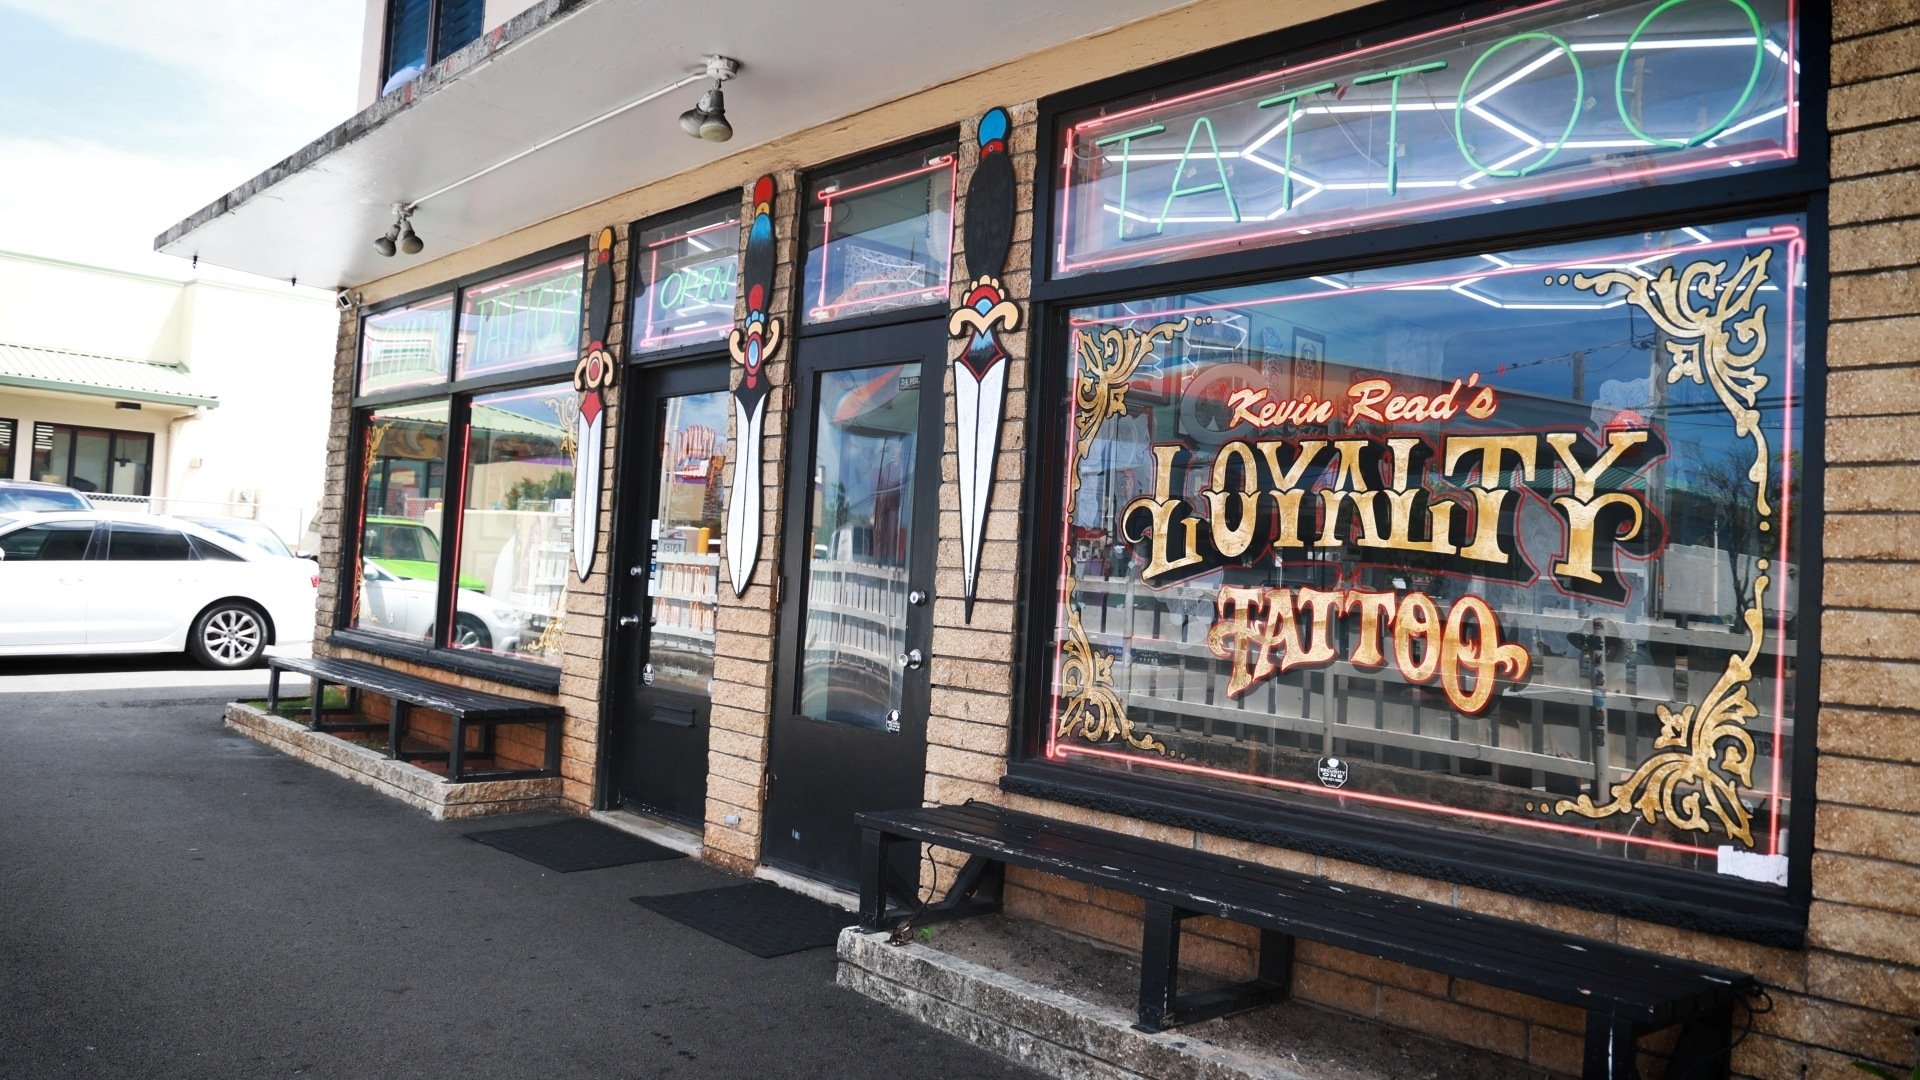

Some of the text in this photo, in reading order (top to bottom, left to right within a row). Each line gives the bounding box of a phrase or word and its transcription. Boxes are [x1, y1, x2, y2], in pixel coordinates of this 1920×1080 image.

[1094, 0, 1766, 241] TATTOO
[476, 273, 581, 363] TATTOO
[660, 263, 736, 309] OPEN
[1347, 372, 1498, 429] Read's
[1120, 430, 1651, 585] LOYALTY
[665, 564, 710, 599] HOURS
[1207, 584, 1533, 716] TATTOO
